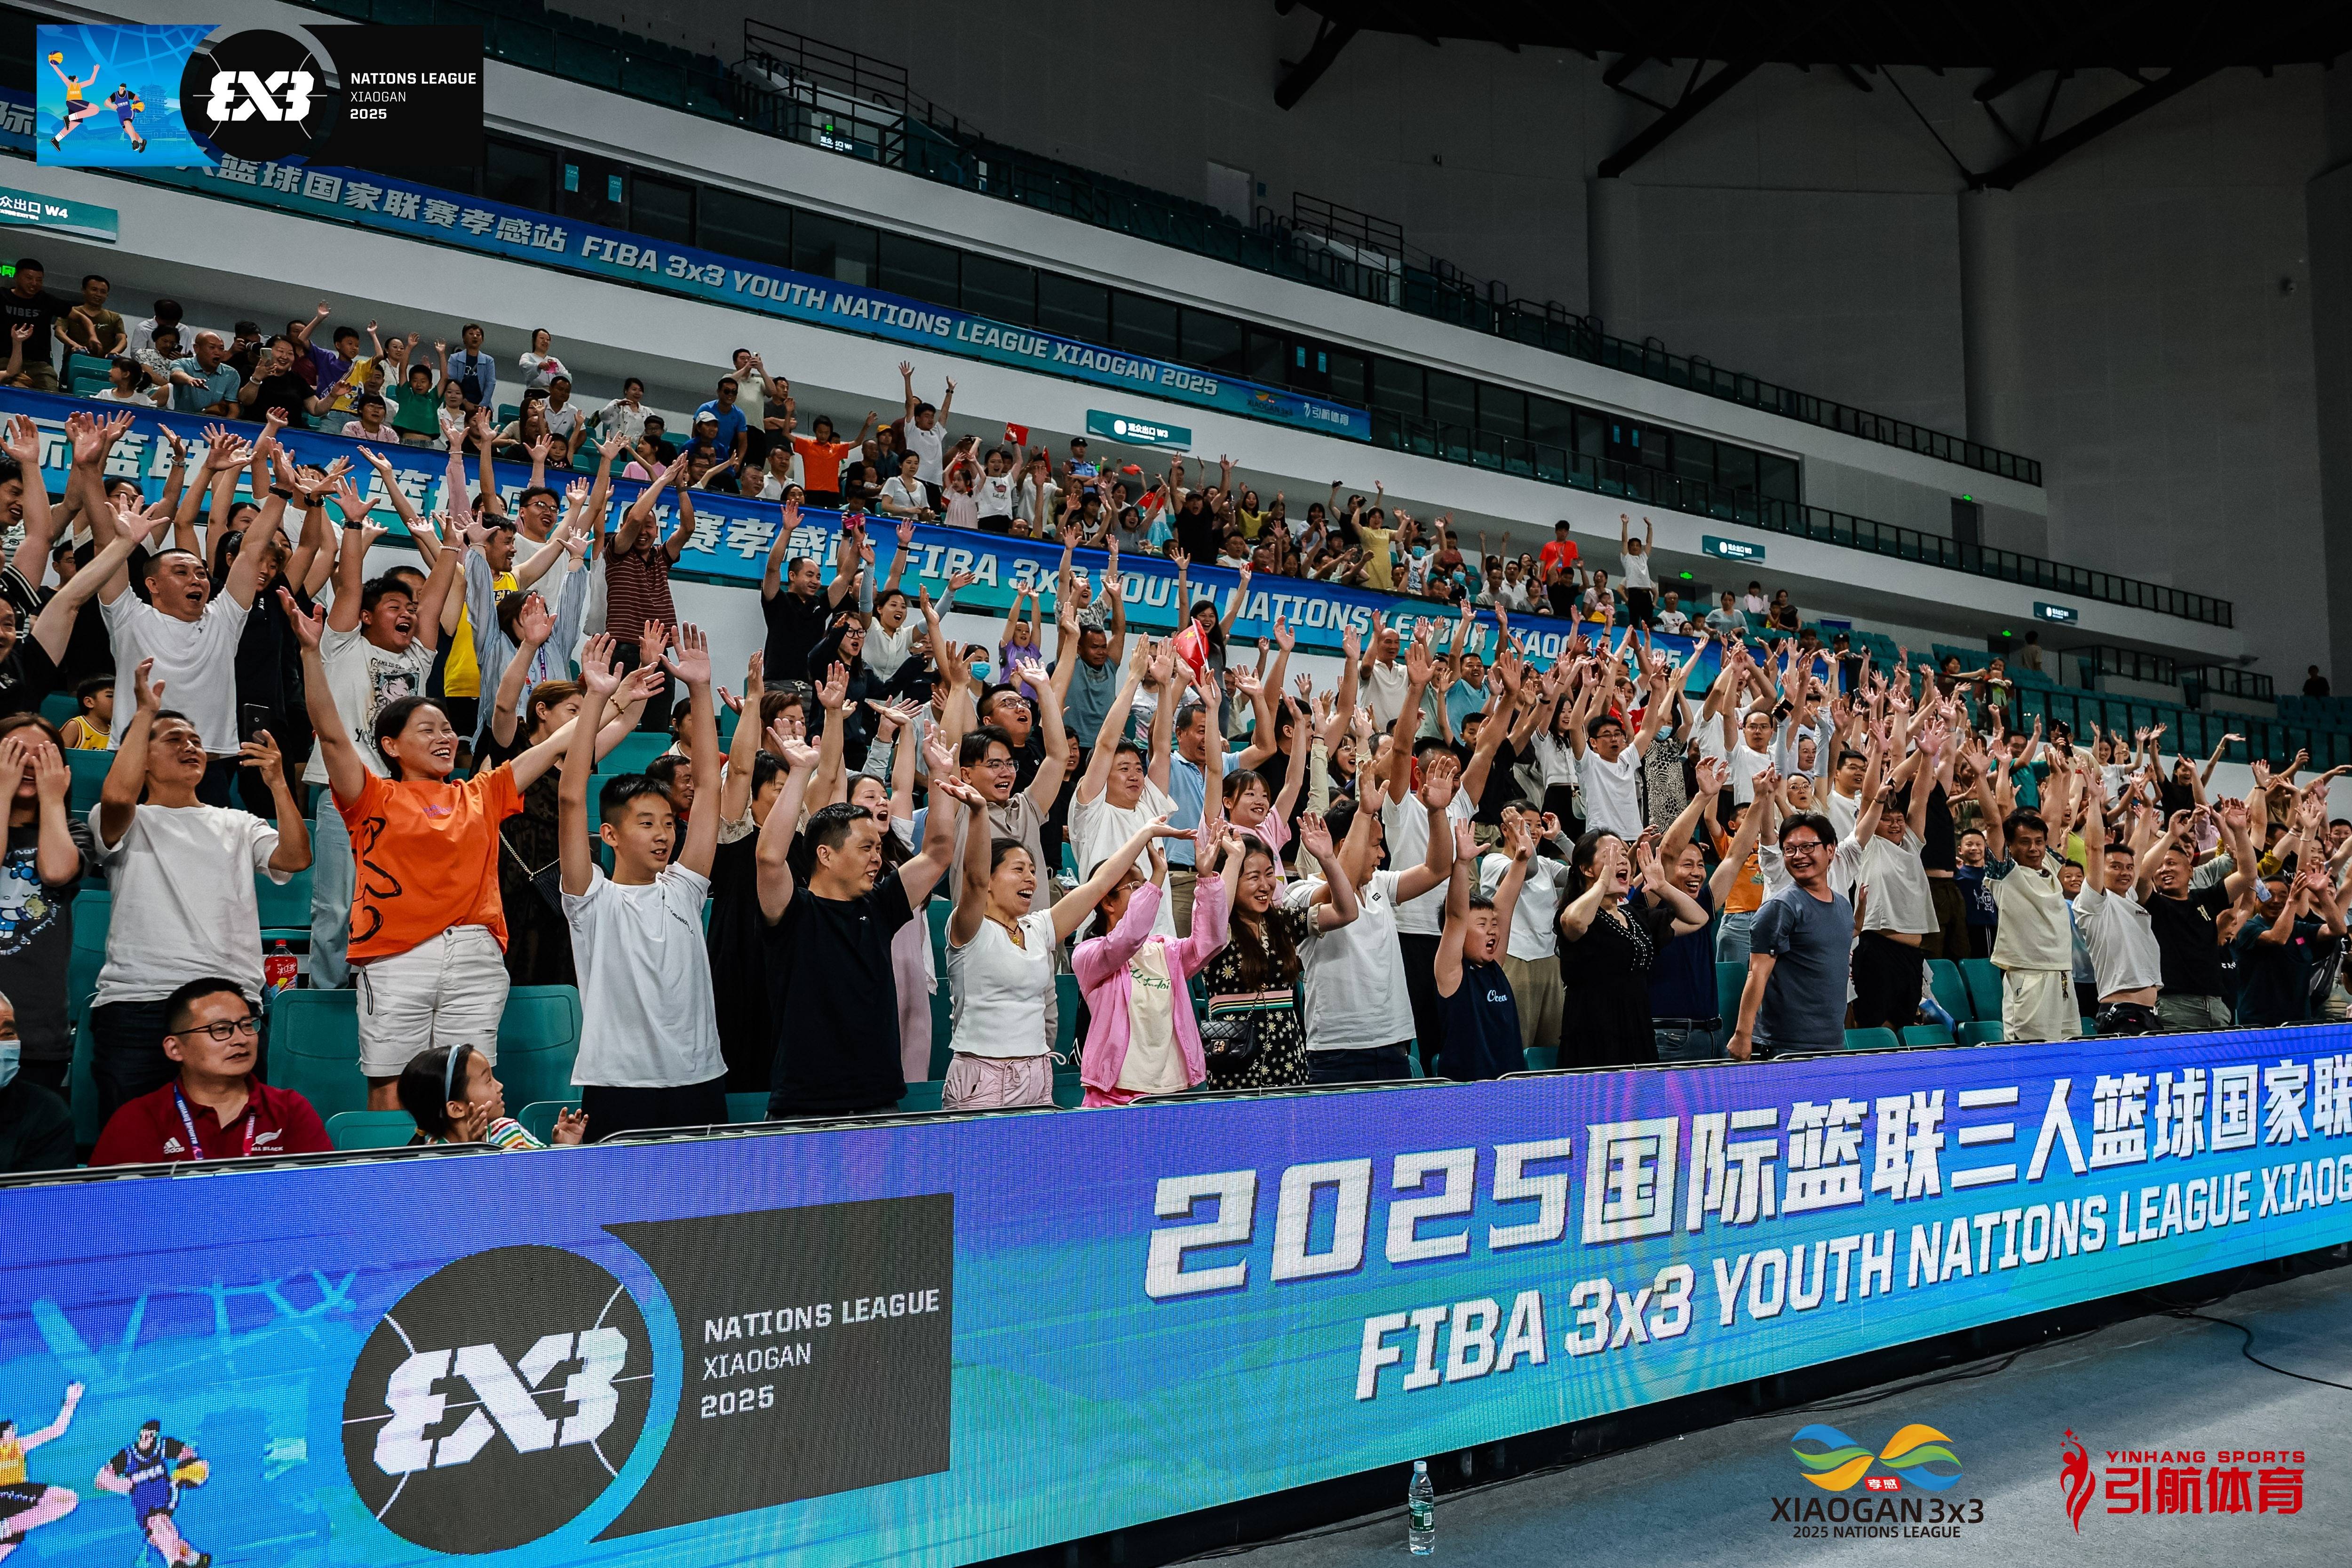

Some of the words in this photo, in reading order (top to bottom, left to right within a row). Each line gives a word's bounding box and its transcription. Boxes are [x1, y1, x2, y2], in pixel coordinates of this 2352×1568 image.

[45, 205, 68, 219] W4
[6, 305, 39, 317] VIBES
[581, 235, 657, 272] FIBA
[666, 255, 725, 287] 3x3
[734, 270, 826, 310] YOUTH
[832, 294, 951, 337] NATIONS
[956, 322, 1049, 359] LEAGUE
[1053, 343, 1156, 382] XIAOGAN
[1161, 368, 1218, 396] 2025
[1157, 429, 1168, 438] W3
[903, 542, 998, 588] FIBA
[1355, 1290, 1546, 1401] FIBA
[1565, 1263, 1694, 1356] 3x3
[1712, 1229, 1895, 1325] YOUTH
[1907, 1195, 2107, 1289] NATIONS
[2117, 1170, 2251, 1246] LEAGUE
[2258, 1154, 2352, 1218] XIAOG
[704, 1301, 832, 1344] NATIONS
[842, 1288, 940, 1324] LEAGUE
[702, 1343, 811, 1380] XIAOGAN
[700, 1385, 774, 1419] 2025
